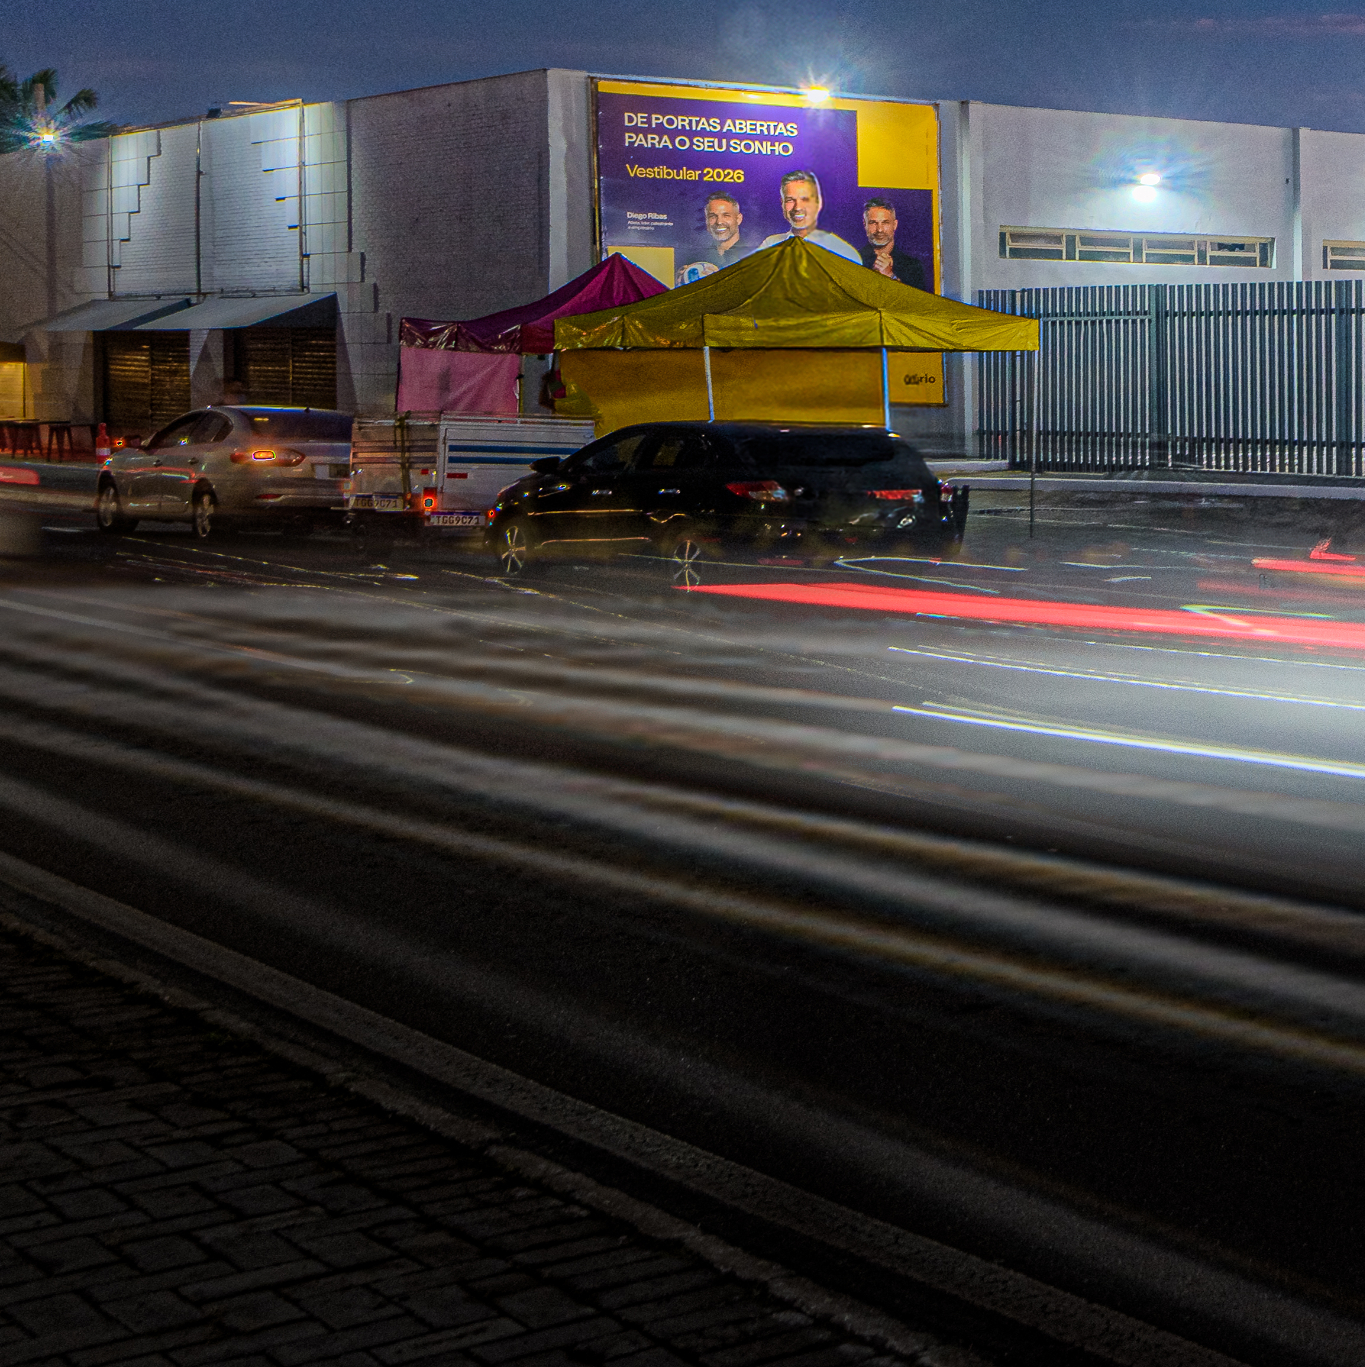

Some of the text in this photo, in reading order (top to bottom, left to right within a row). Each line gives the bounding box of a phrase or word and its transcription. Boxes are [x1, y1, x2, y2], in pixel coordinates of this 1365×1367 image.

[624, 112, 798, 137] DE PORTAS ABERTAS
[624, 133, 793, 156] PARA O SEU SONHO
[626, 164, 745, 183] Vestibular 2026
